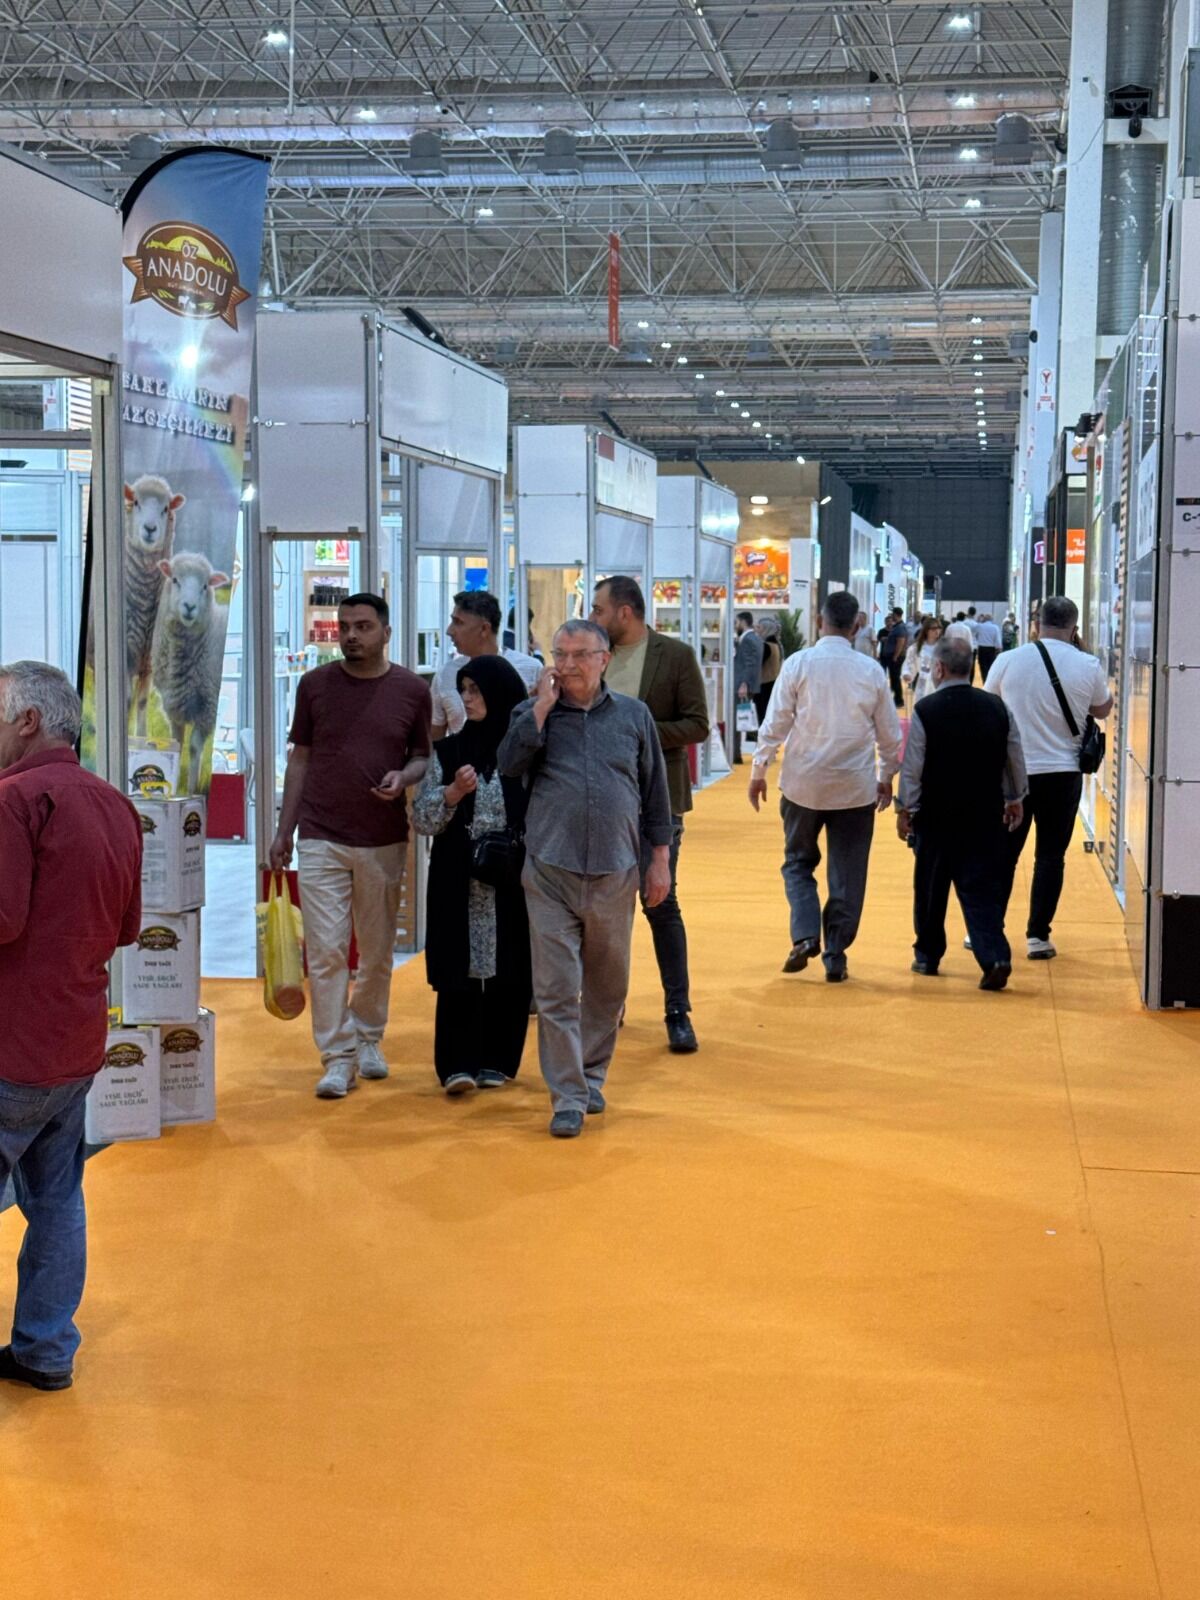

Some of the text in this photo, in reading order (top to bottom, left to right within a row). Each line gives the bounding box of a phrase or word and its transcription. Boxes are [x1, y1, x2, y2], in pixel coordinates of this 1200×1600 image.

[182, 240, 199, 260] ÖZ
[146, 257, 228, 296] ANADOLU
[122, 404, 234, 443] AZGEÇİLMEZİ
